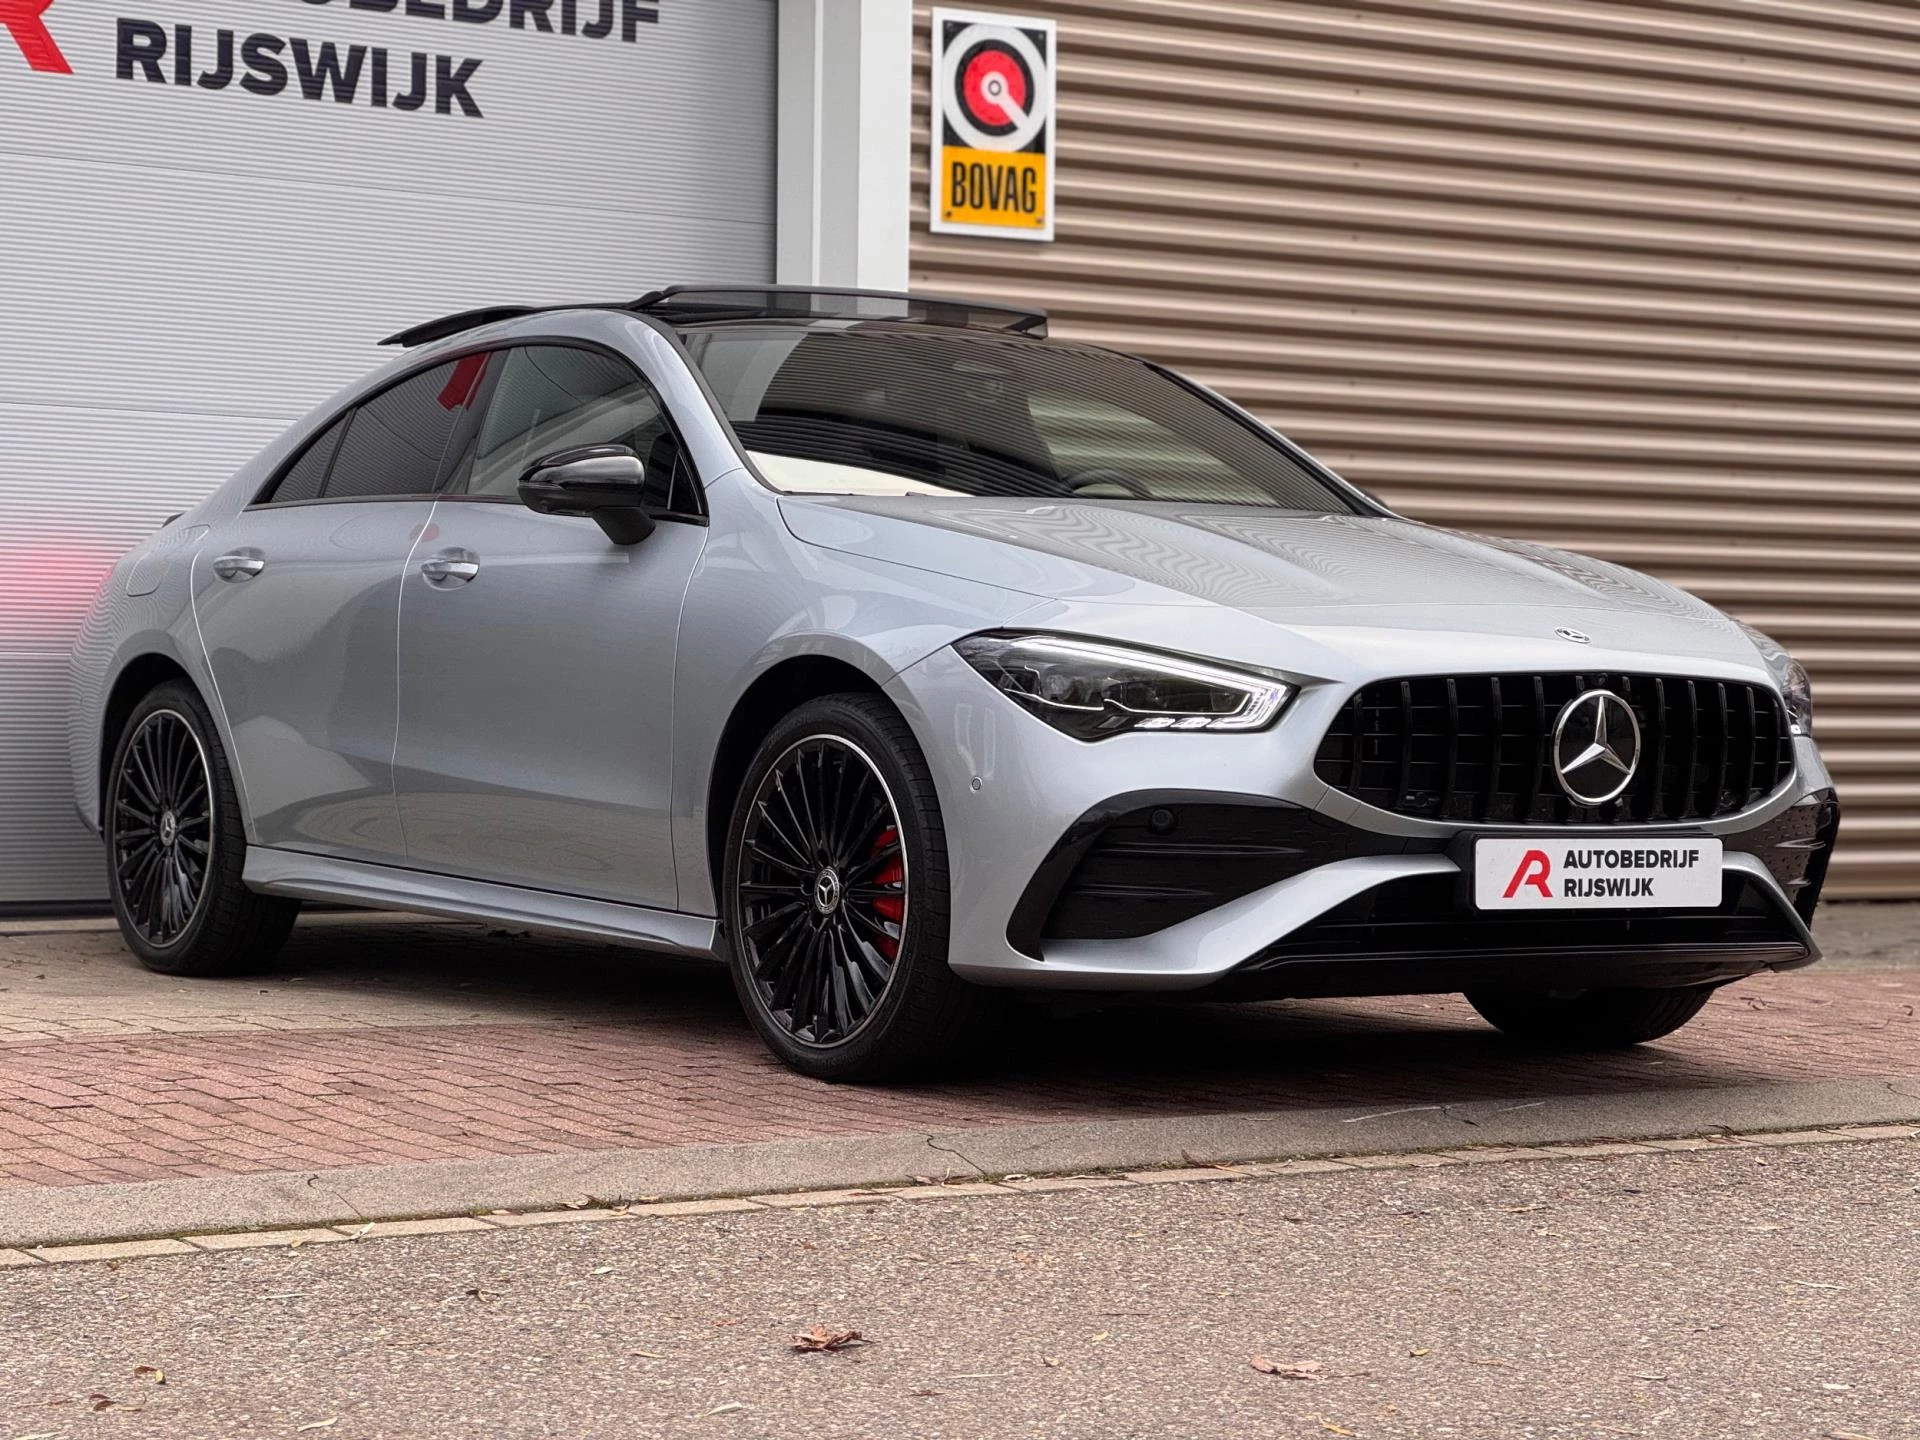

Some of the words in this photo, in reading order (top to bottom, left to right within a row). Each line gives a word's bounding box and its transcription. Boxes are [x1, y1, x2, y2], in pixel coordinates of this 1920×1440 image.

[115, 17, 484, 118] RIJSWIJK
[951, 161, 1036, 214] BOVAG
[1563, 849, 1699, 869] AUTOBEDRIJF
[1564, 877, 1654, 897] RIJSWIJK
